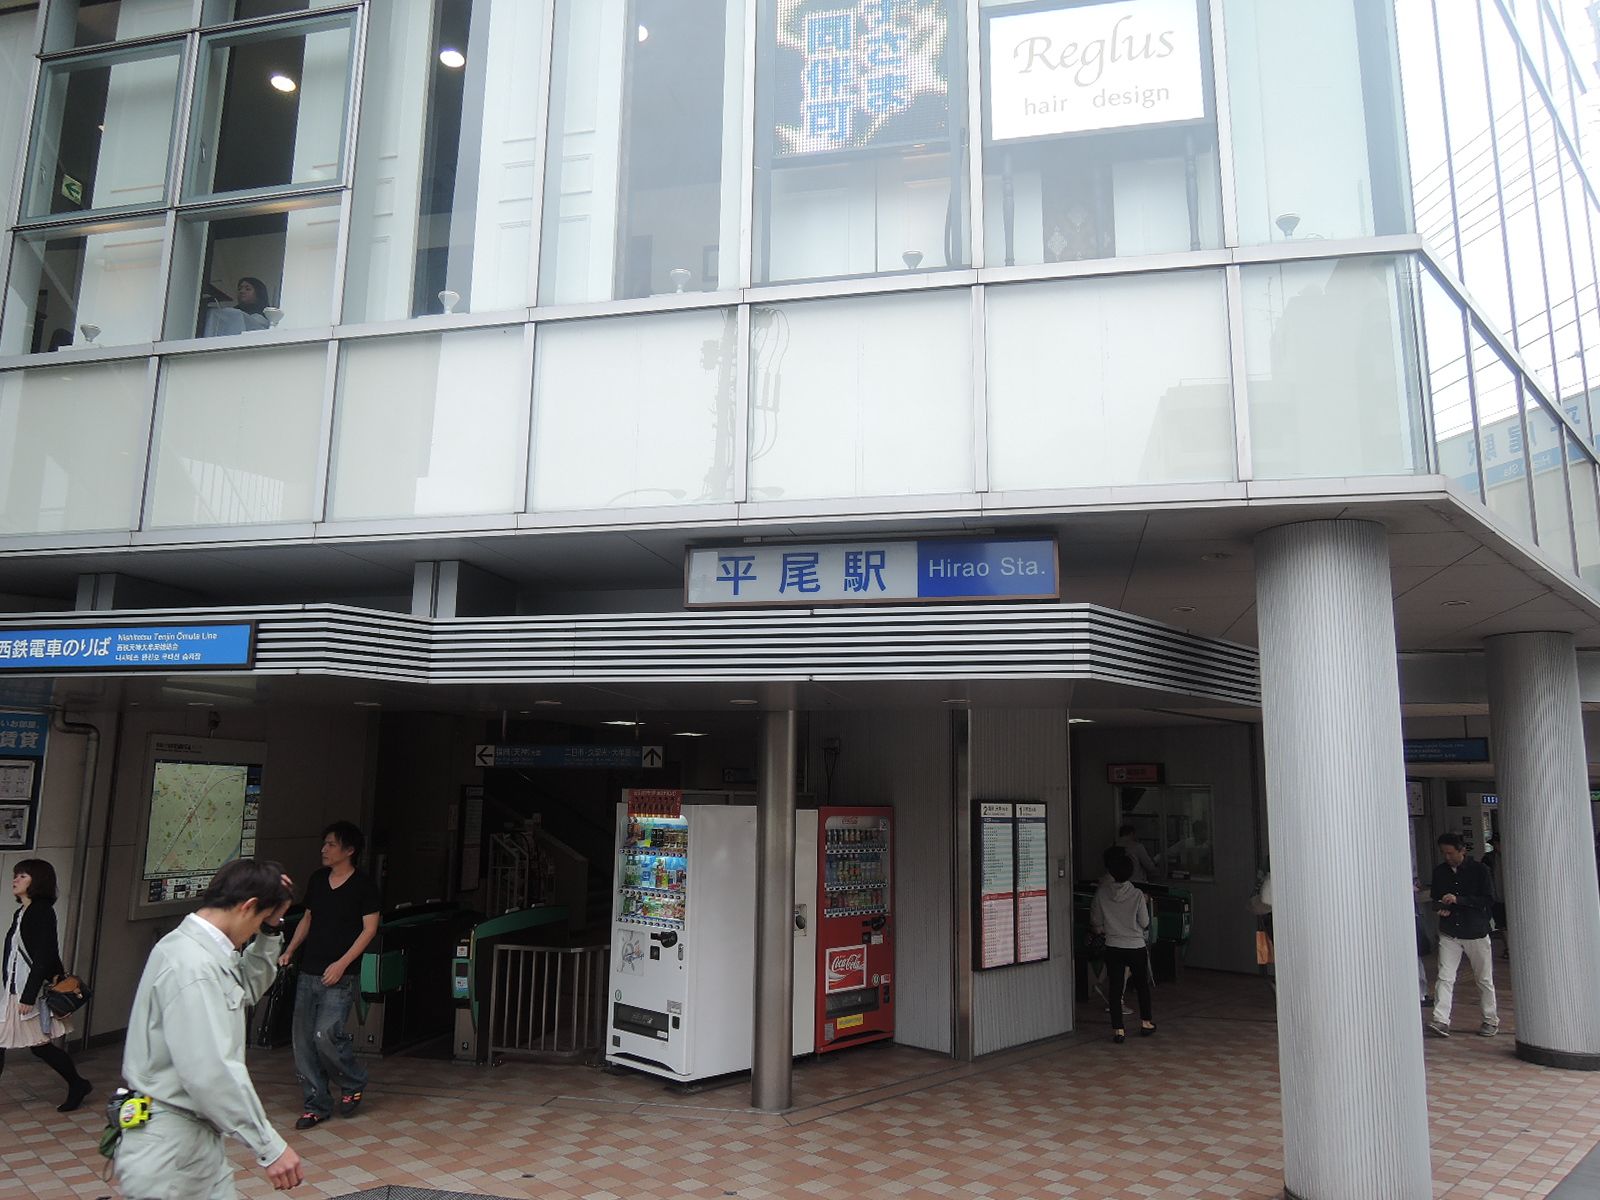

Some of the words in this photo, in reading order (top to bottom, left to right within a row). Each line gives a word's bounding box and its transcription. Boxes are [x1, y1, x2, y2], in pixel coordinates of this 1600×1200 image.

[1013, 15, 1175, 88] Reglus
[1023, 94, 1069, 117] hair
[1092, 85, 1171, 110] design
[715, 549, 888, 596] 平尾駅
[928, 556, 990, 578] Hirao
[1000, 556, 1046, 576] Sta.
[0, 637, 112, 659] 西鉄電車のりば
[831, 953, 864, 972] Coca-Cola
